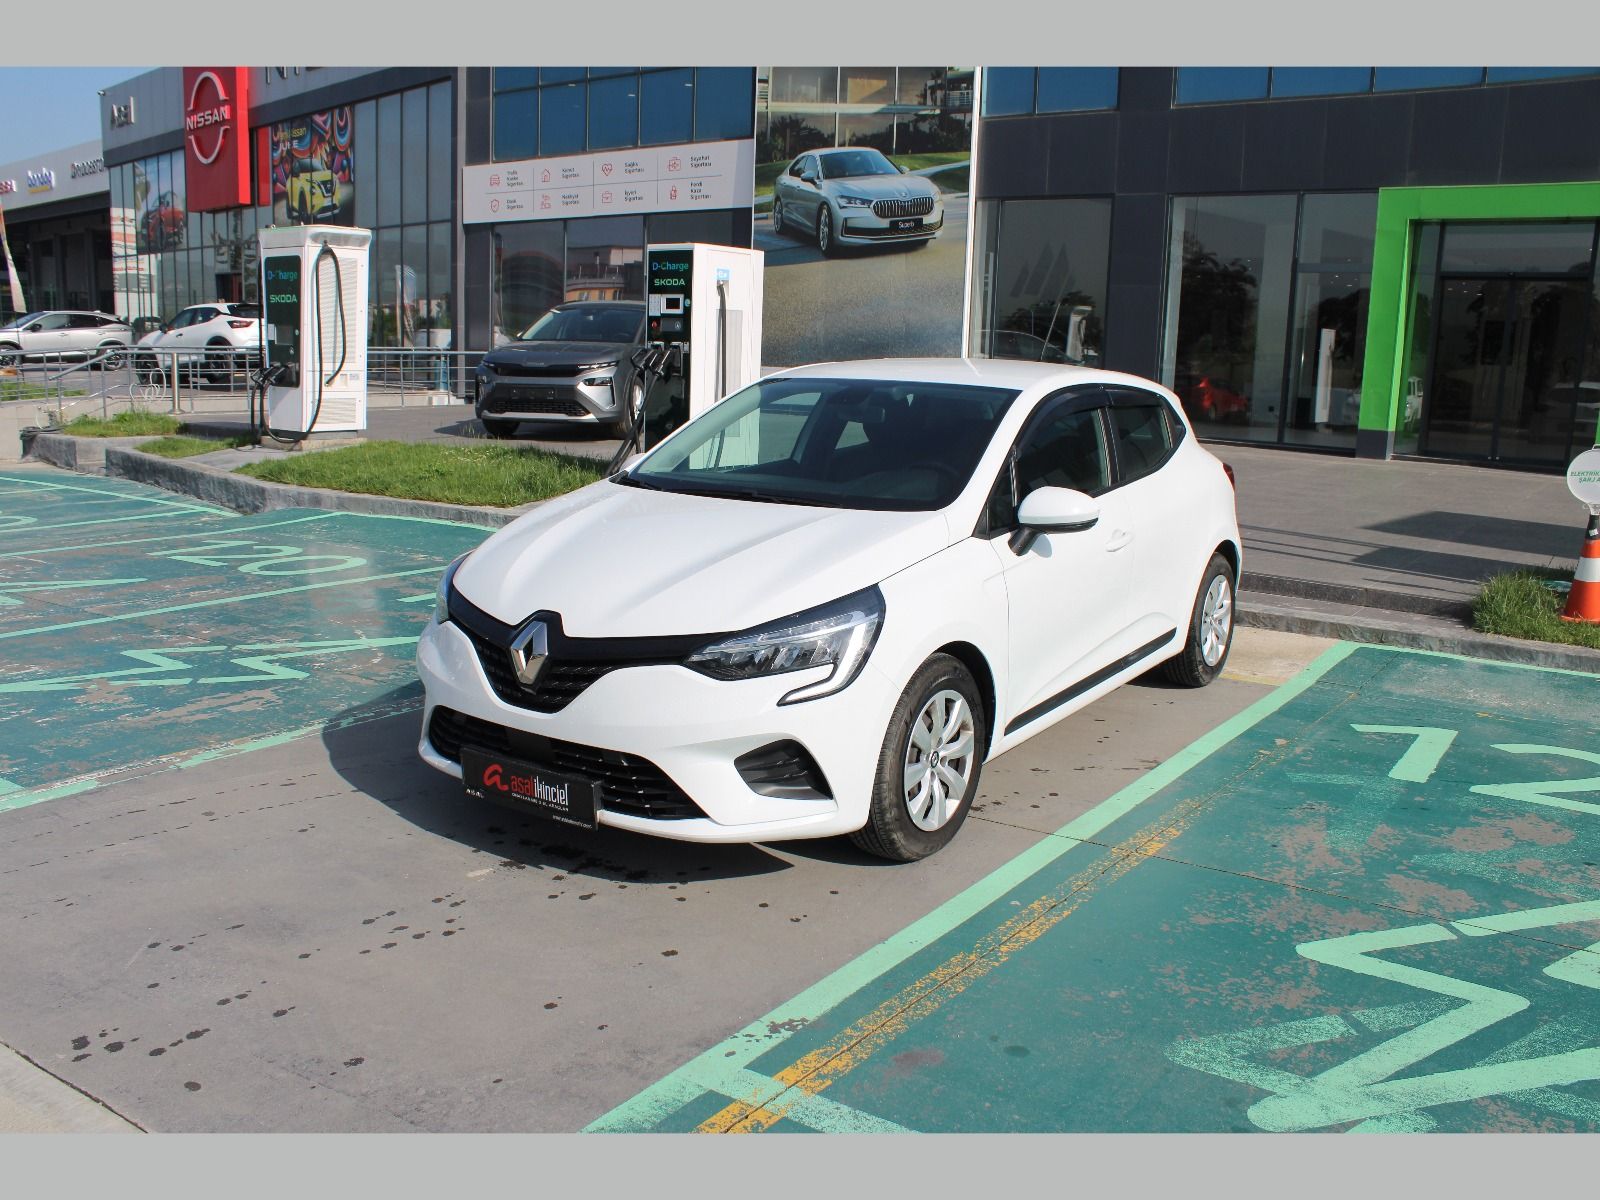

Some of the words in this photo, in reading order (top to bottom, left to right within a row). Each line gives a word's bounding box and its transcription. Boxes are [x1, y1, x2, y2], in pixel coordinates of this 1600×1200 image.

[187, 105, 230, 130] NISSAN
[899, 221, 914, 229] Superb
[652, 260, 689, 272] D-Charge
[267, 270, 298, 282] D-harge
